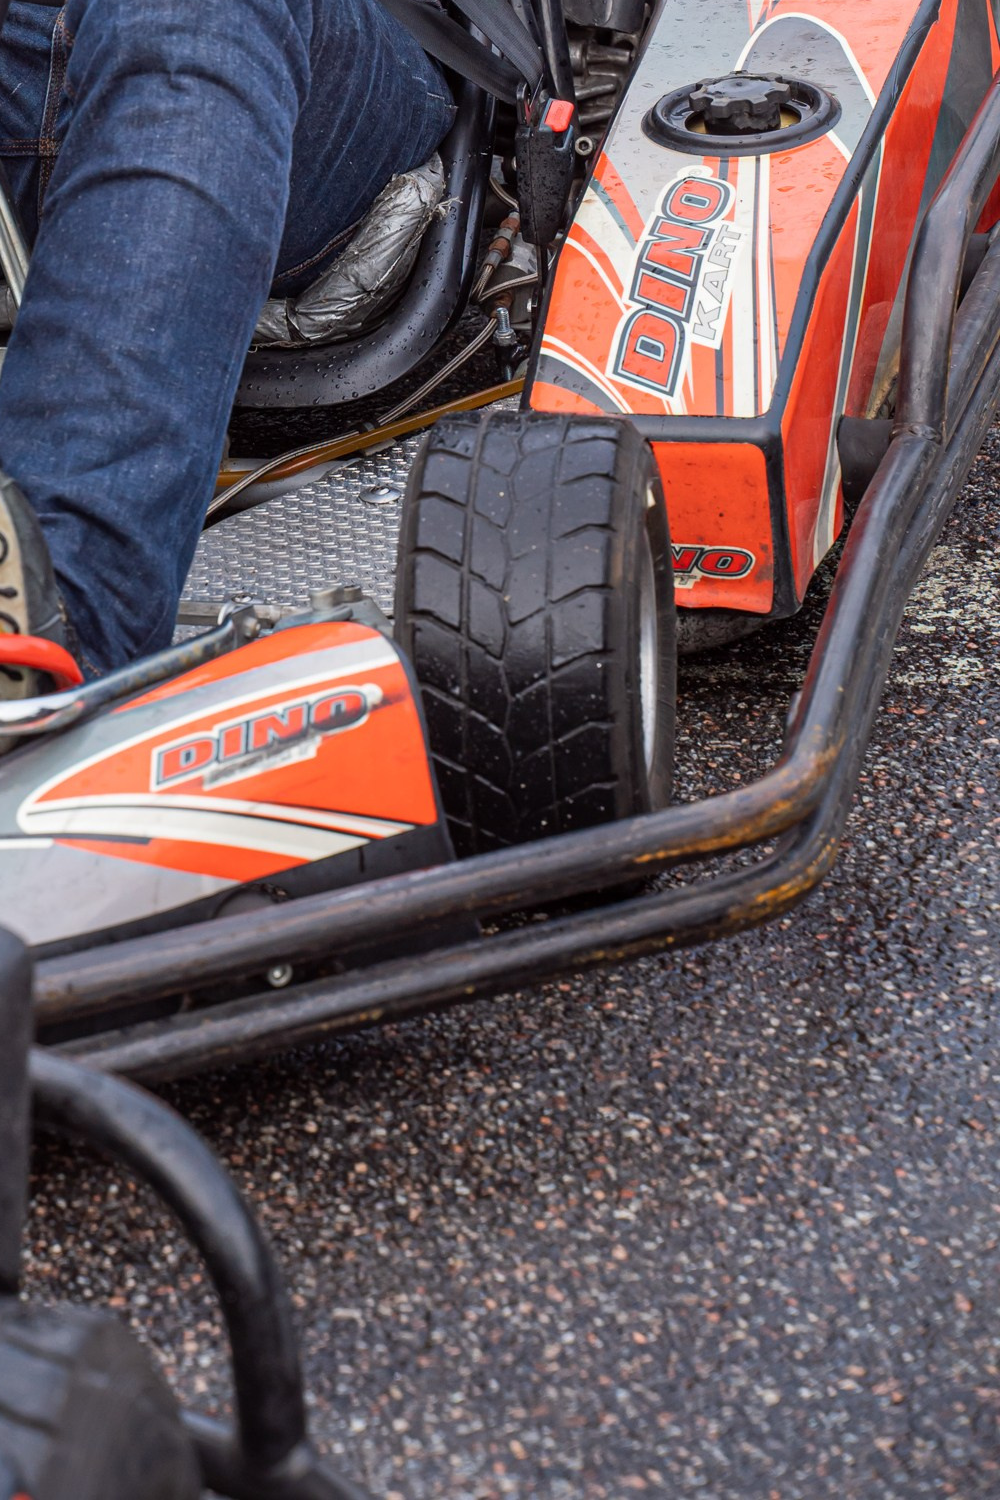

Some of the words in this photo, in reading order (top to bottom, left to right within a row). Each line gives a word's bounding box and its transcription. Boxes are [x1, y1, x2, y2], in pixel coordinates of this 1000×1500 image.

[612, 176, 731, 398] DINO
[692, 224, 741, 341] KART
[671, 545, 754, 577] NO
[156, 690, 369, 786] DINO
